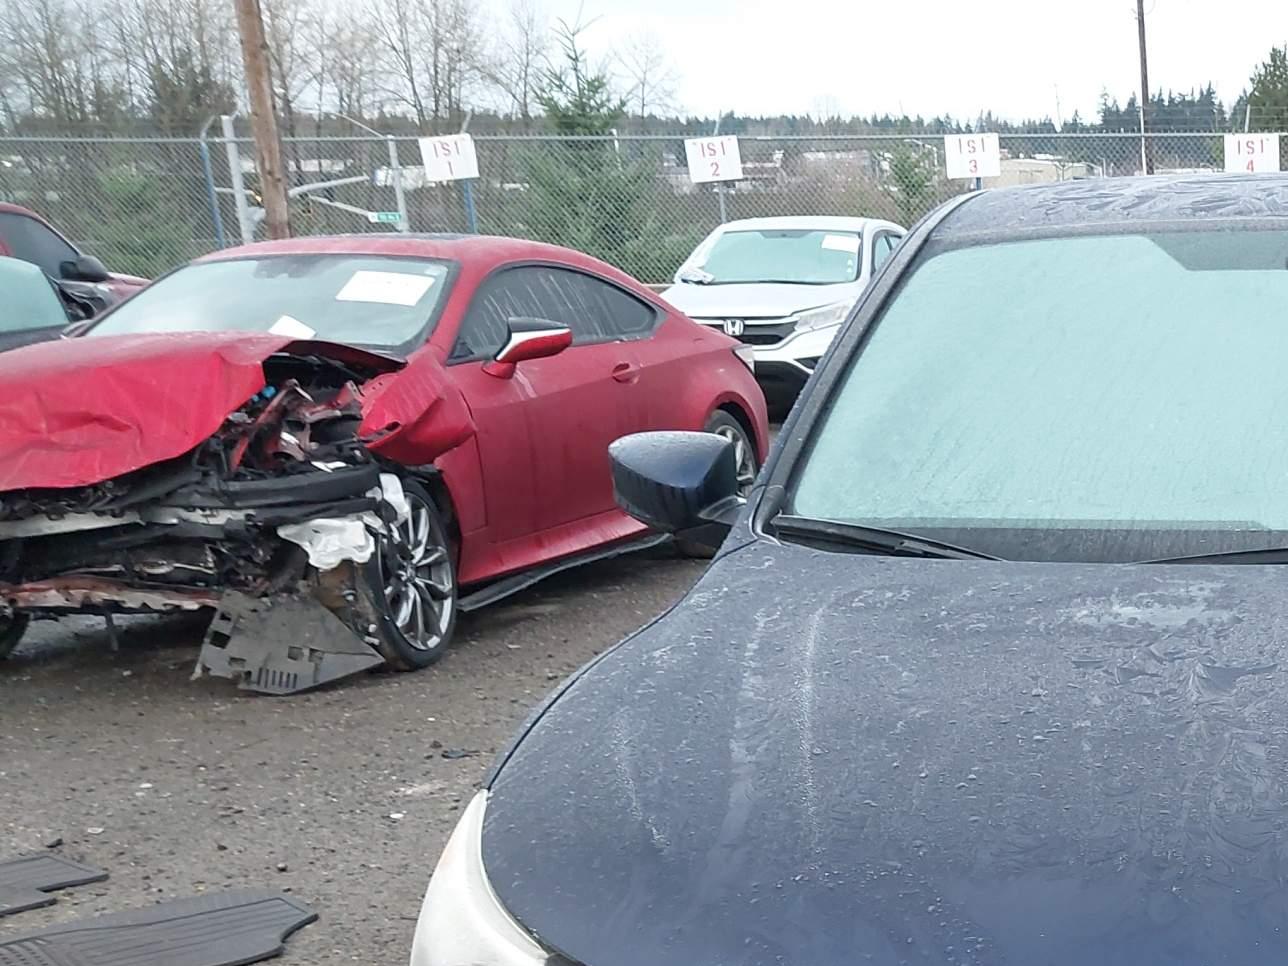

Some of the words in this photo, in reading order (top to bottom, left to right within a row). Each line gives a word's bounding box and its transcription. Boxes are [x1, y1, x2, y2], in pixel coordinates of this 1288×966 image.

[710, 161, 721, 177] 2
[968, 159, 978, 174] 3
[1246, 159, 1255, 173] 4
